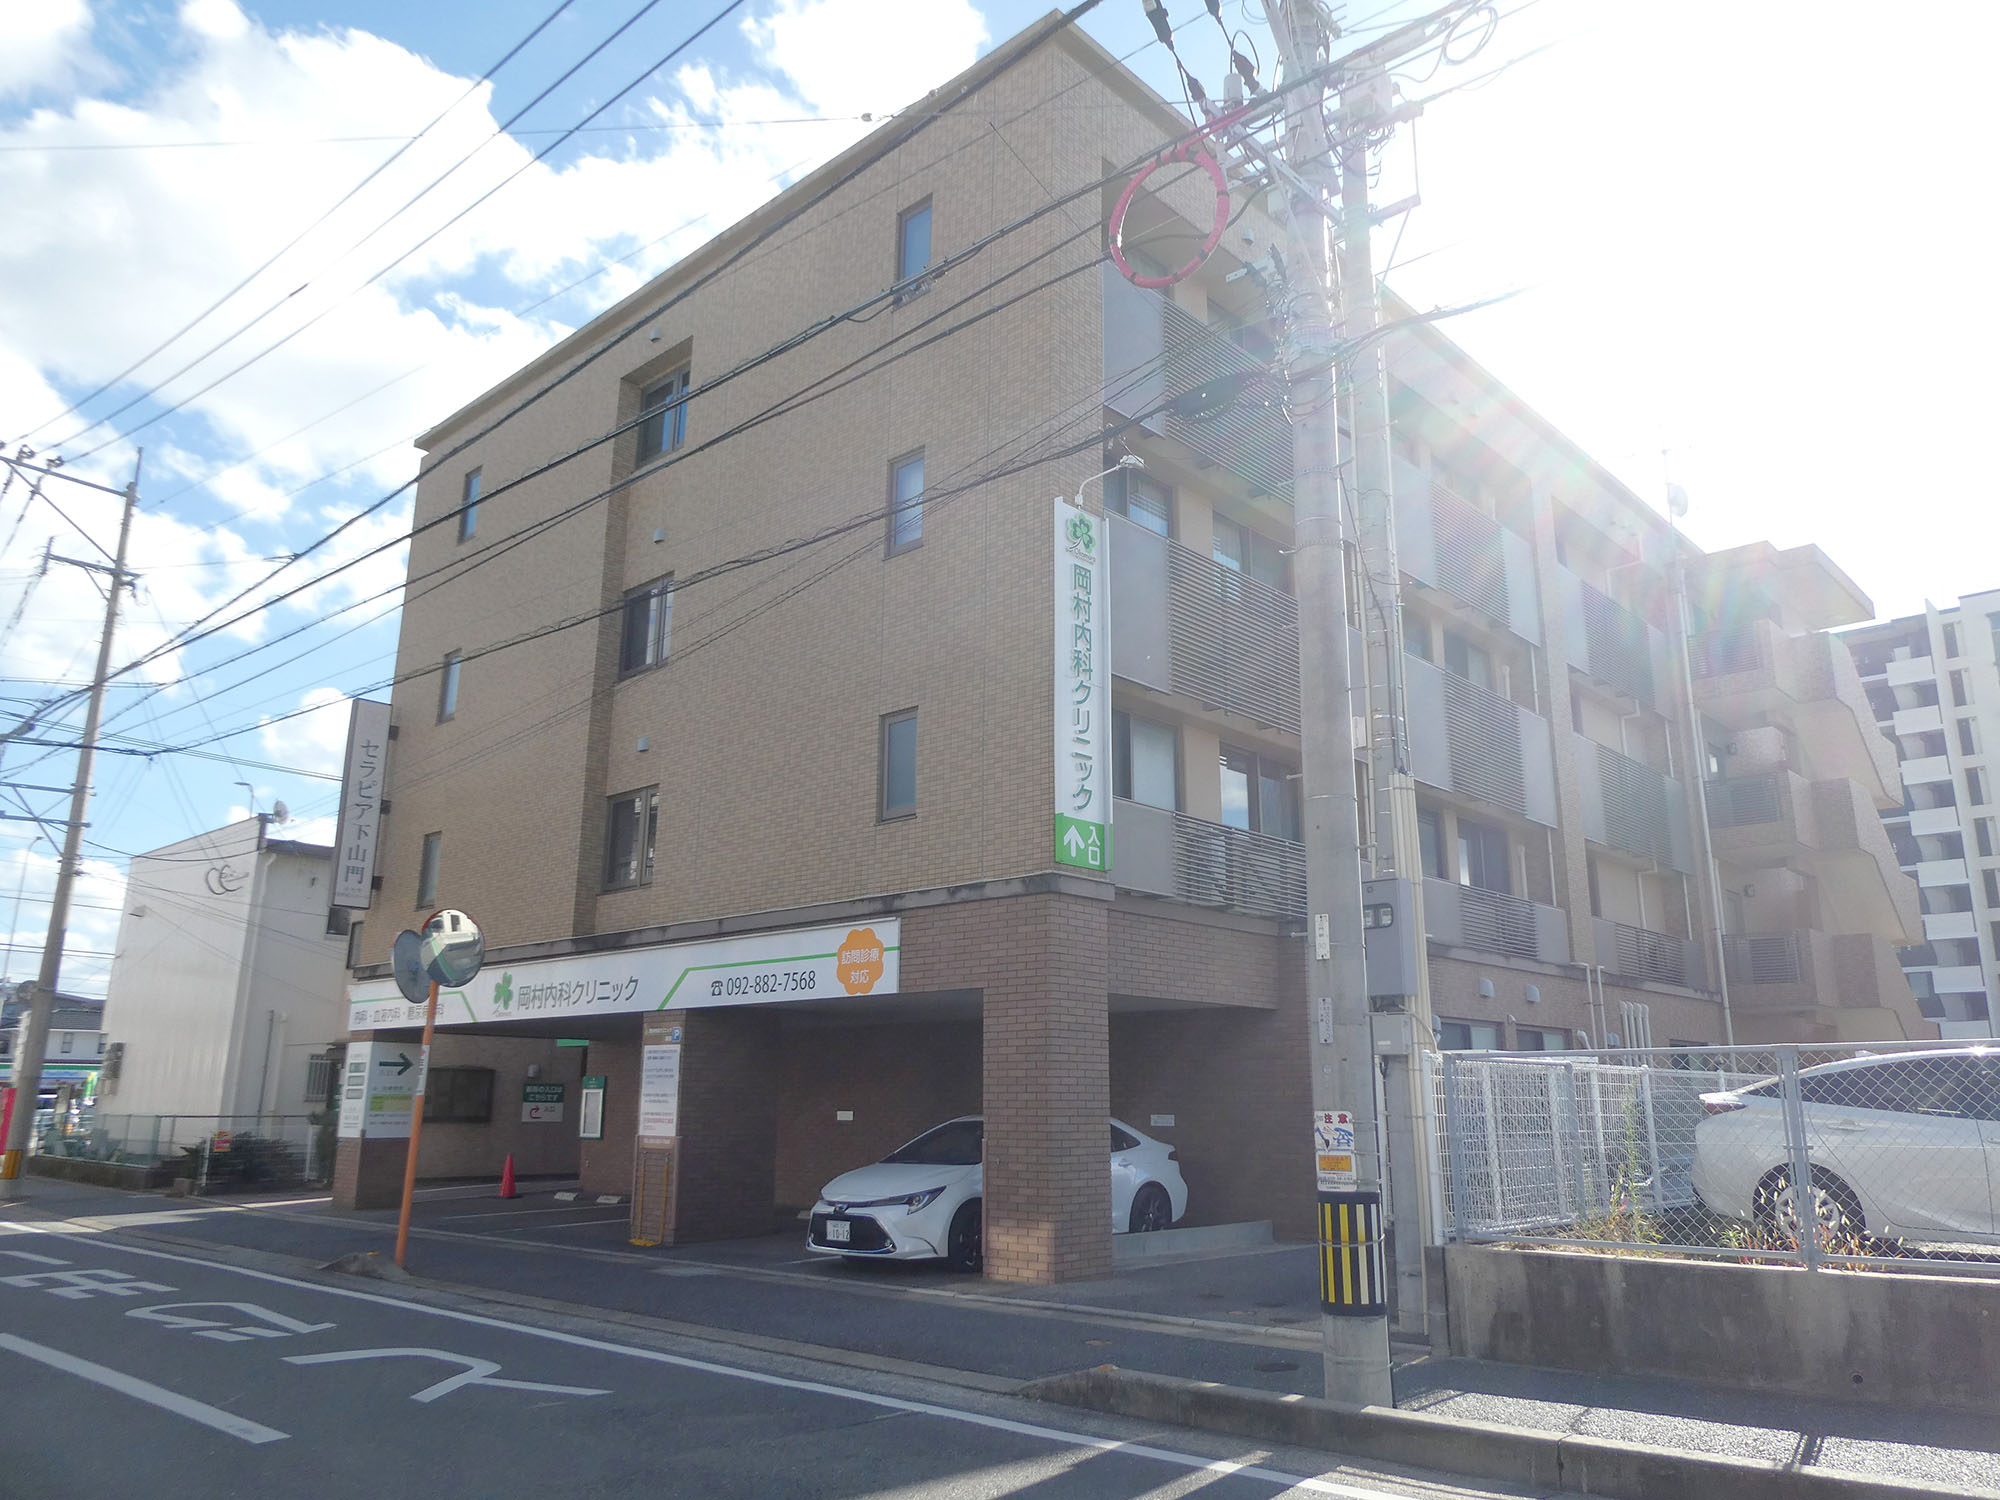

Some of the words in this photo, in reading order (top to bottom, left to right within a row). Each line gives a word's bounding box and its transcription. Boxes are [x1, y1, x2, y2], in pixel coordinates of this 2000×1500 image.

[1072, 563, 1094, 811] 岡村内科クリニック
[344, 739, 380, 885] セラピア下山門
[1087, 825, 1101, 866] 入口
[841, 947, 880, 965] 訪問診療
[517, 975, 640, 1010] 岡村内科クリニック
[726, 970, 816, 996] 092-882-7568
[849, 969, 870, 985] 対応
